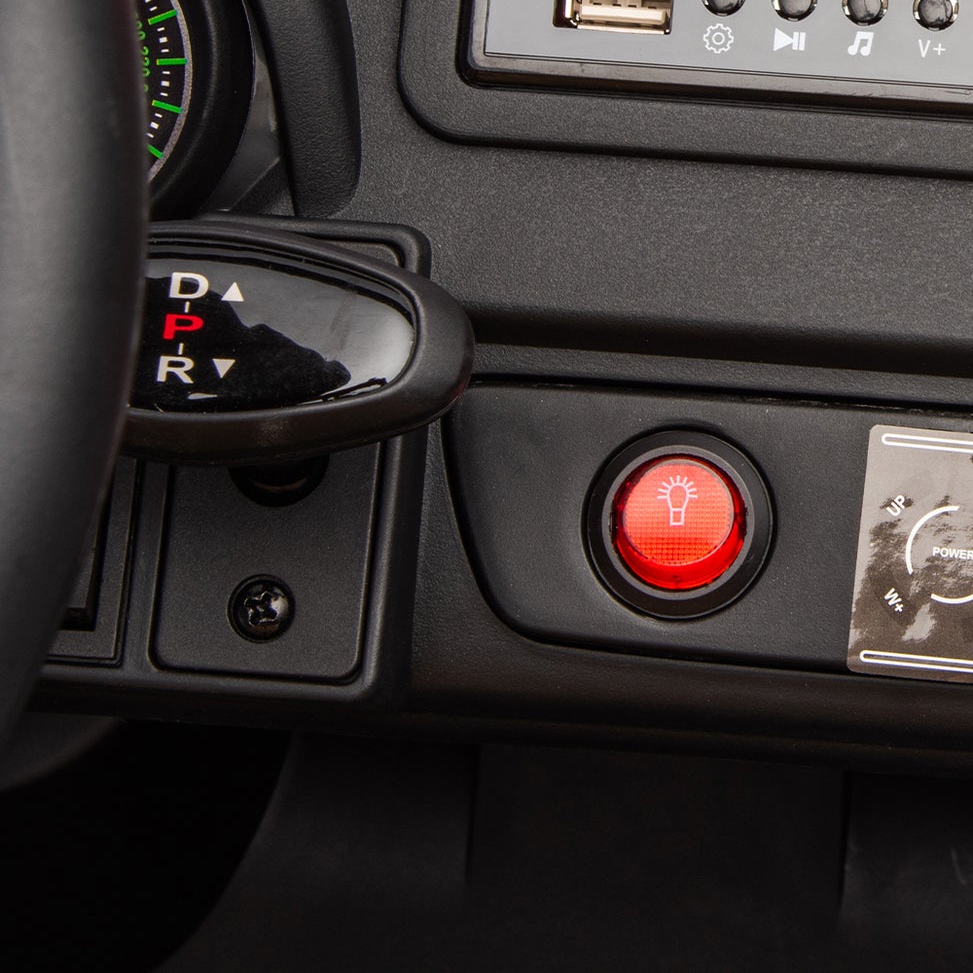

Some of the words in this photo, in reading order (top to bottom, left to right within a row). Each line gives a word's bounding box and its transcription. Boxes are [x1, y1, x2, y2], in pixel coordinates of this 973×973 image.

[918, 39, 946, 58] V+
[169, 271, 209, 300] D
[163, 313, 204, 340] P
[156, 355, 195, 384] R
[885, 494, 907, 517] UP
[884, 587, 904, 613] W+
